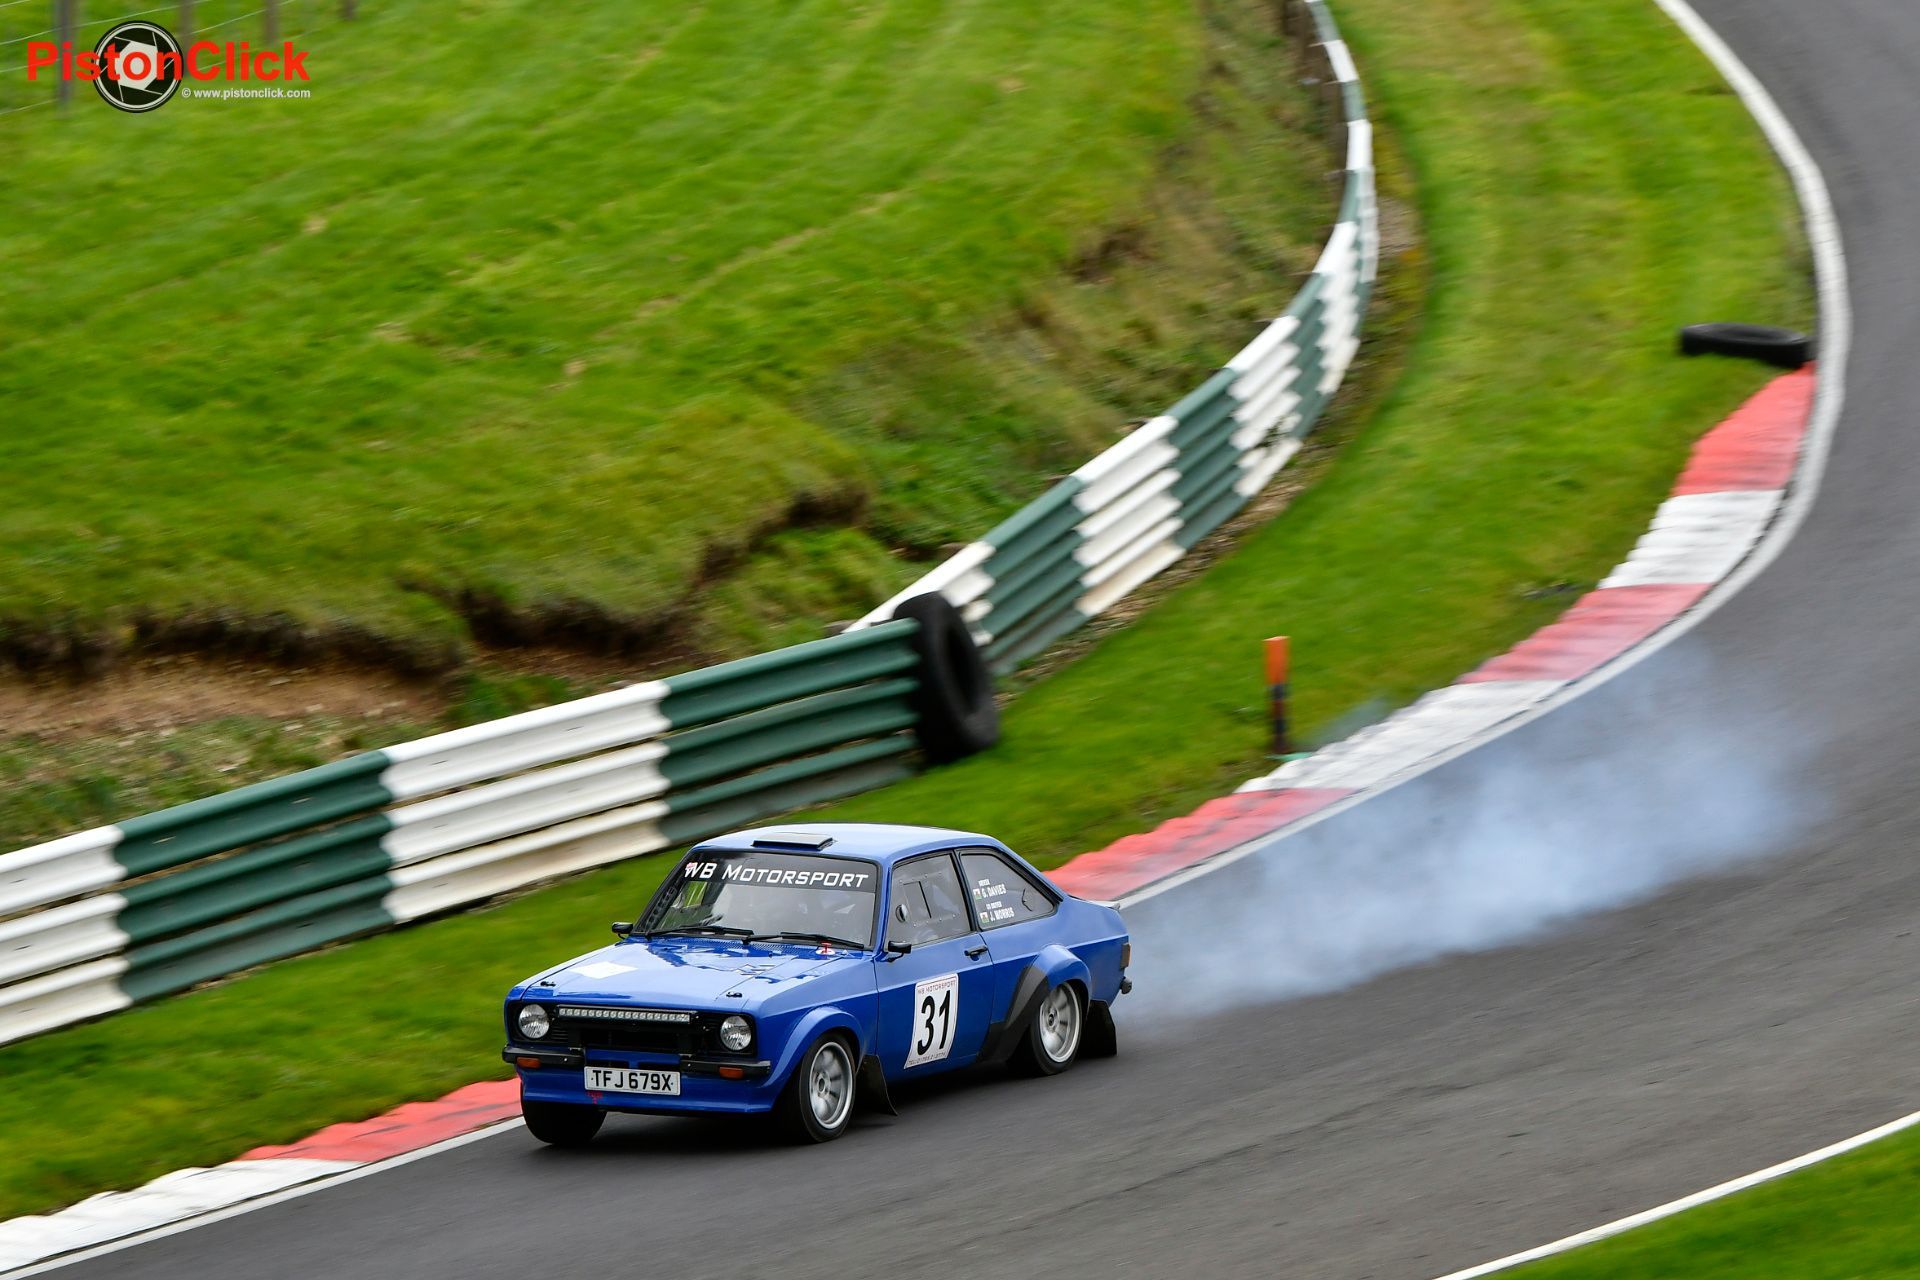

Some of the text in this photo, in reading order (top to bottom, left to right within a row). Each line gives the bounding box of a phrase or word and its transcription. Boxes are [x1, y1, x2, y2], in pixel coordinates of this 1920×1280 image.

[684, 862, 869, 887] WB MOTORSPORT
[988, 883, 1007, 897] DAVIES
[994, 907, 1015, 920] MORRIS
[926, 980, 956, 992] MOTORSPORT
[917, 990, 951, 1056] 31
[592, 1070, 672, 1091] TFJ 679X
